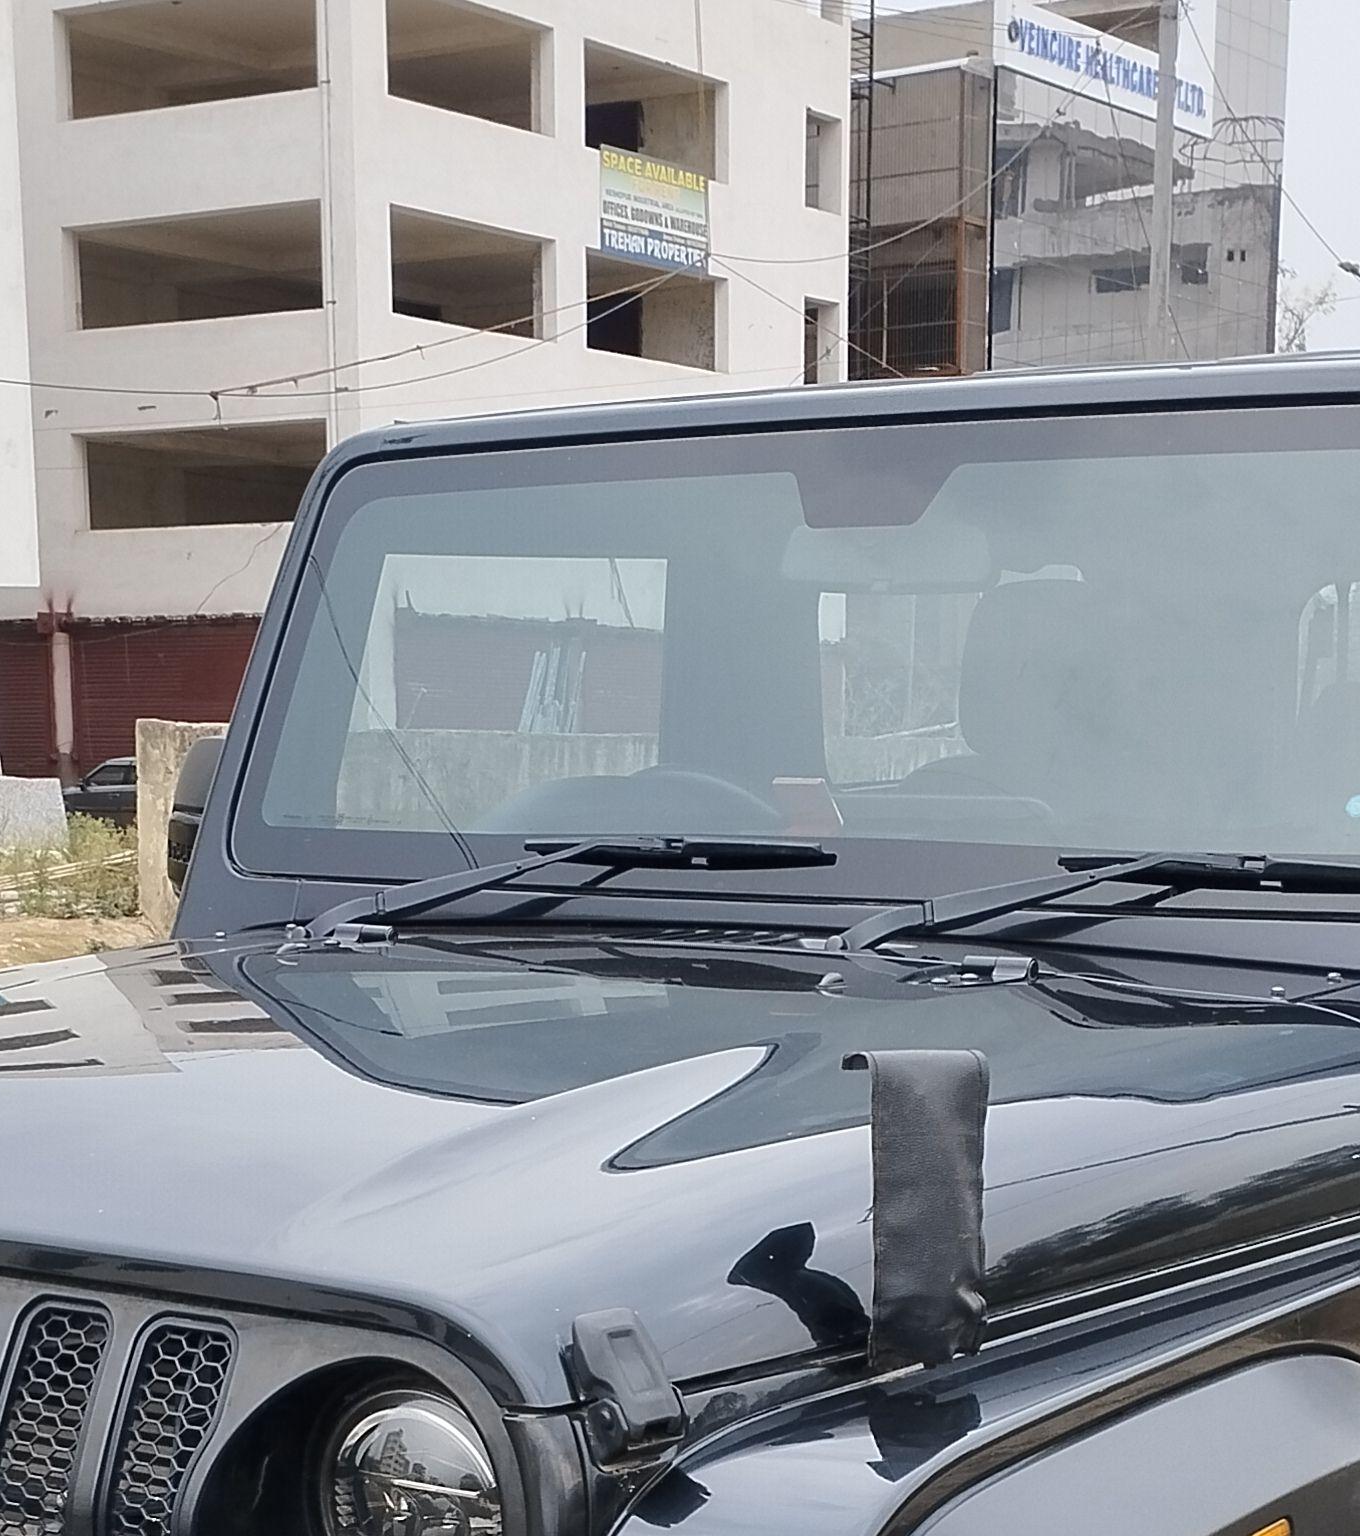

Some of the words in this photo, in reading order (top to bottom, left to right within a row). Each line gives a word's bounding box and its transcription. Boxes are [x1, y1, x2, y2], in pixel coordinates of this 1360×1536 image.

[1019, 19, 1081, 72] VEINCURE
[602, 150, 642, 176] SPACE
[644, 162, 706, 192] AVAILABLE
[631, 206, 663, 228] GODOWNS
[603, 229, 646, 254] TREHAN
